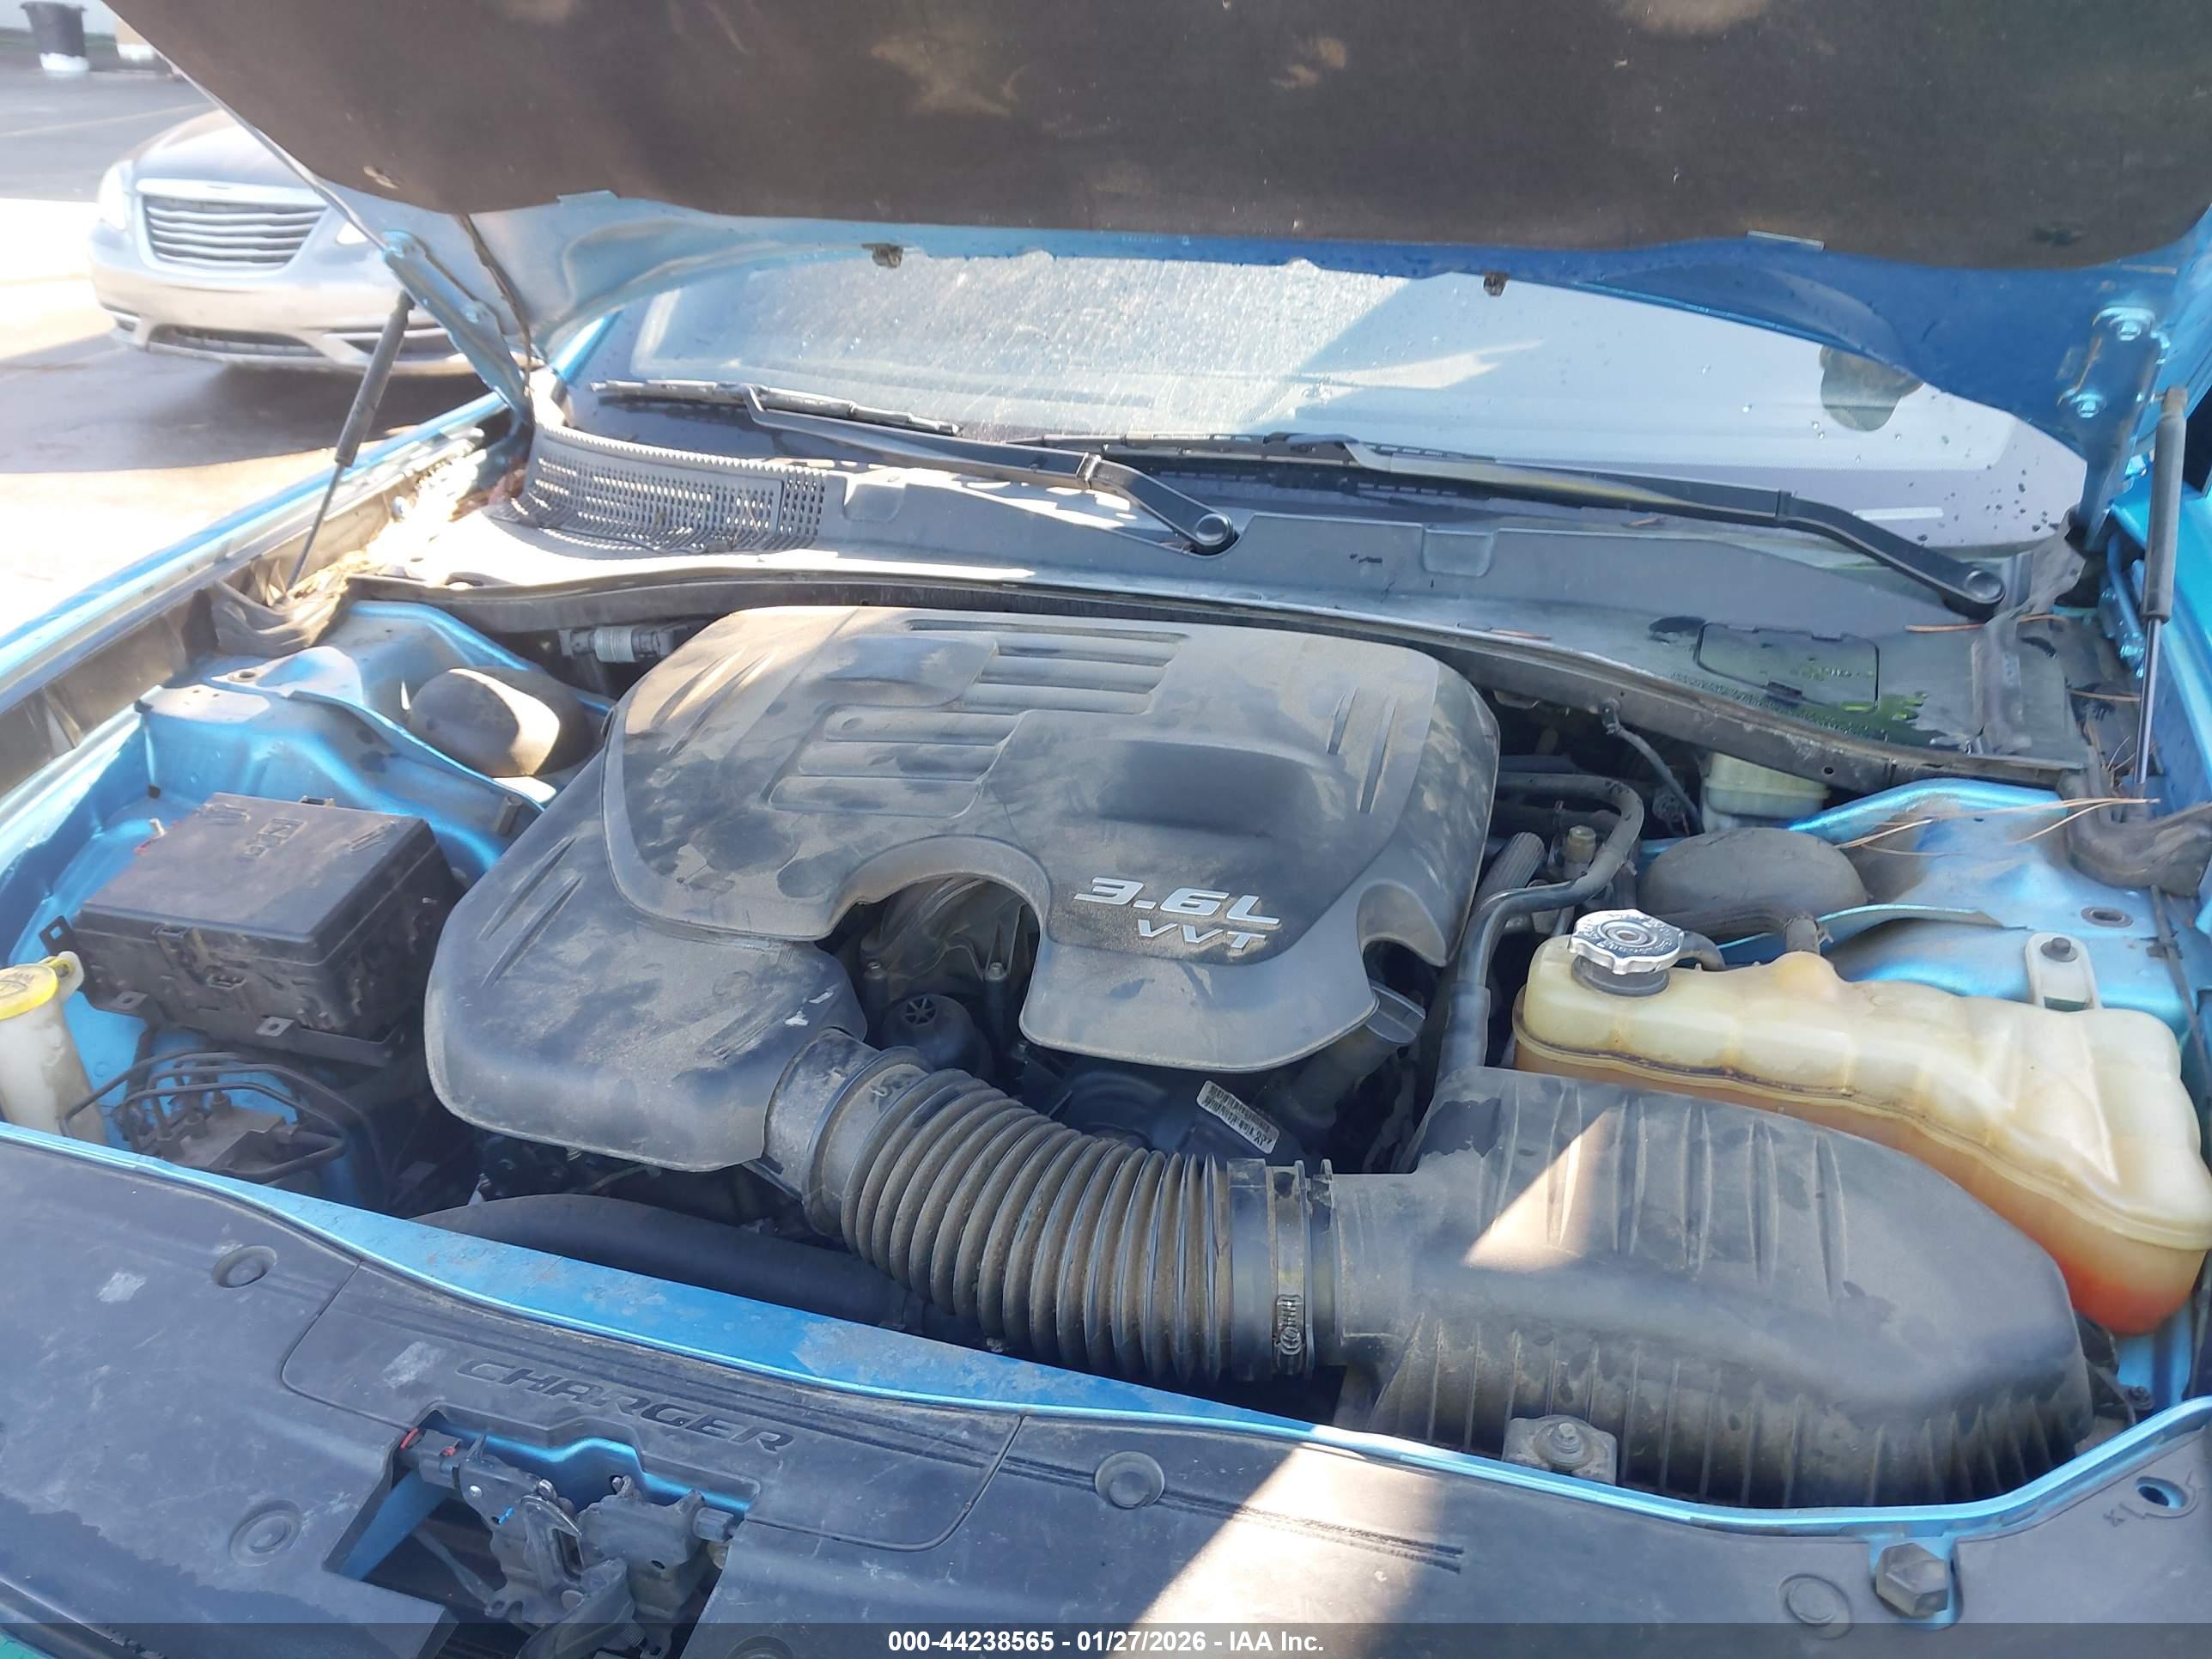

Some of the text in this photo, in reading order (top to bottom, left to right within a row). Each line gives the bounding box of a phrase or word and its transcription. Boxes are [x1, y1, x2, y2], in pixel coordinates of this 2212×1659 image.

[1074, 877, 1280, 925] 3.6L
[1137, 920, 1267, 951] VVT
[456, 1358, 795, 1452] CHARGER
